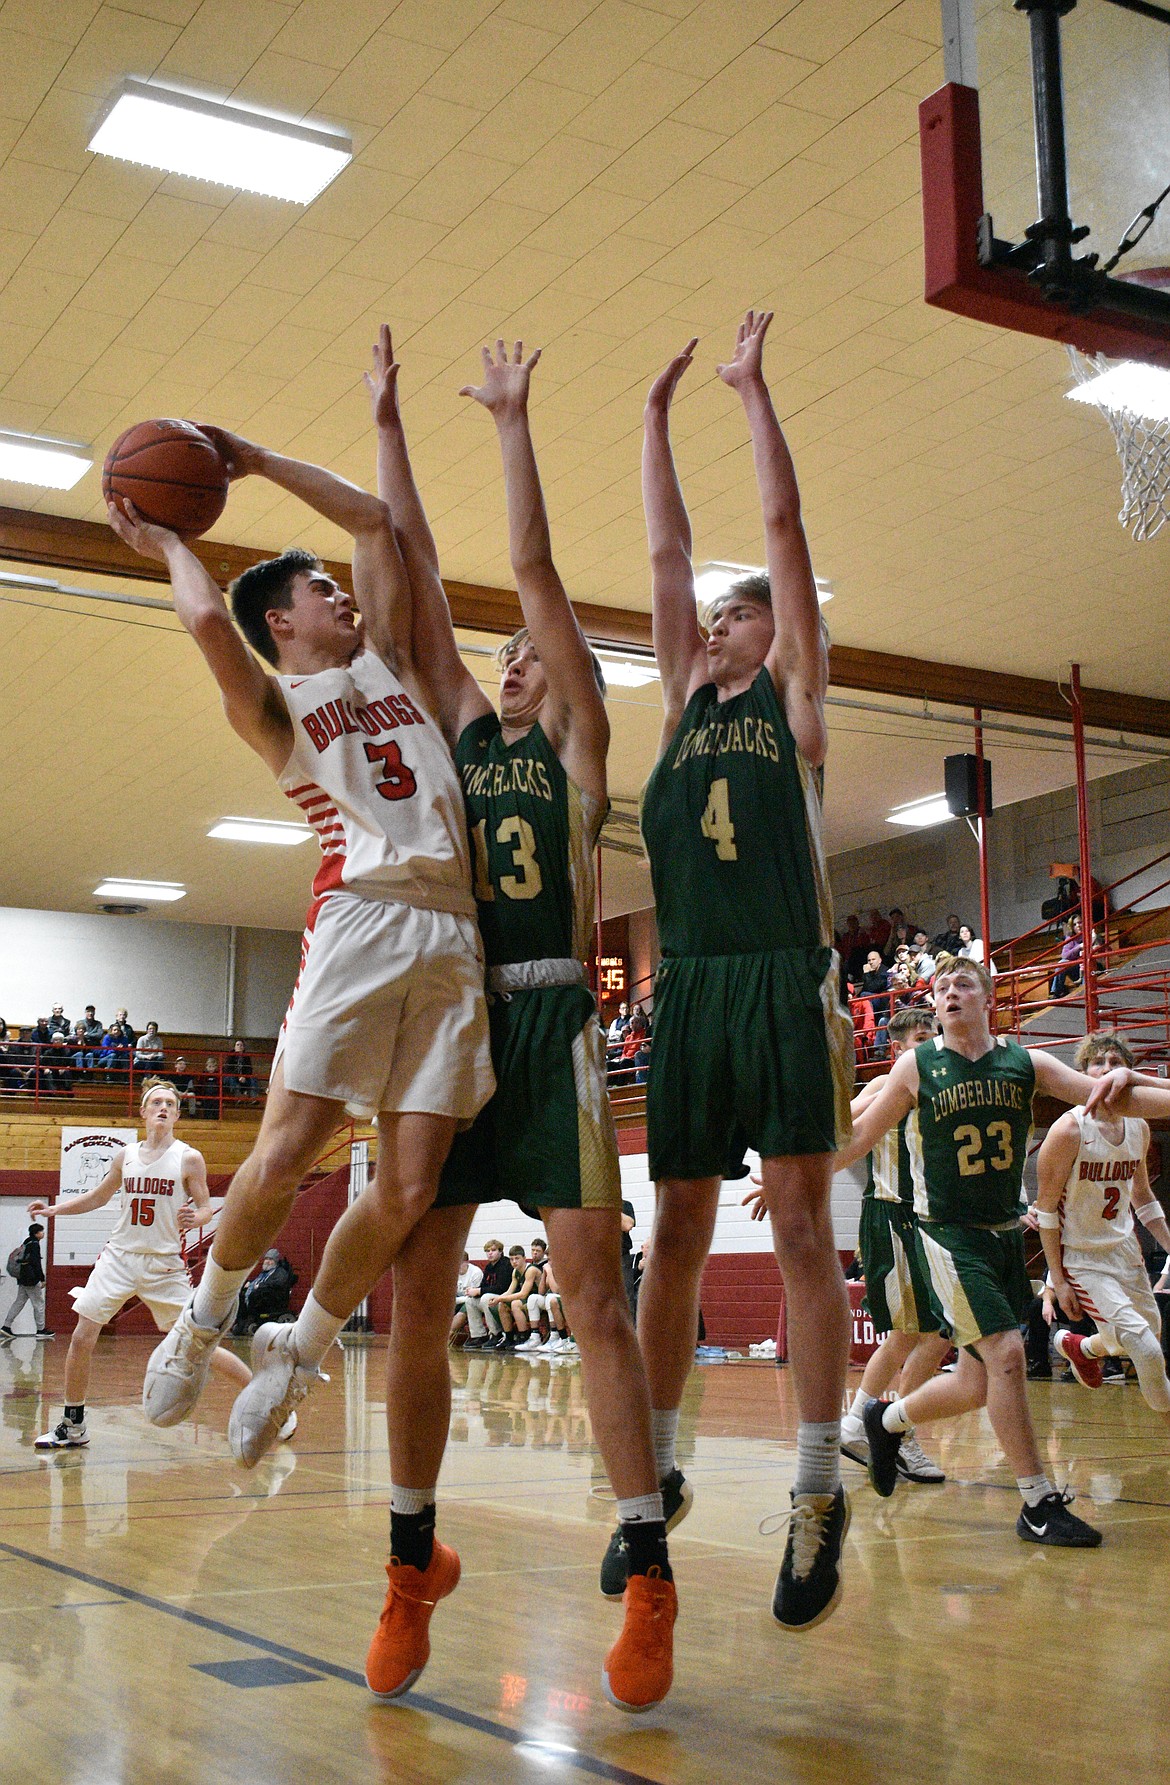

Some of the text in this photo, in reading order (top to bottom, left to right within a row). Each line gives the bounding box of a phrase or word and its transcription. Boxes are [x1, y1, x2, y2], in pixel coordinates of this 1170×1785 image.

[363, 740, 417, 801] 3
[701, 777, 738, 861] 4
[471, 815, 543, 901] 13
[82, 1141, 114, 1149] SCHOOL
[953, 1120, 1014, 1177] 23
[1079, 1159, 1141, 1182] BULLDOG
[130, 1198, 156, 1227] 15
[1101, 1186, 1121, 1221] 2
